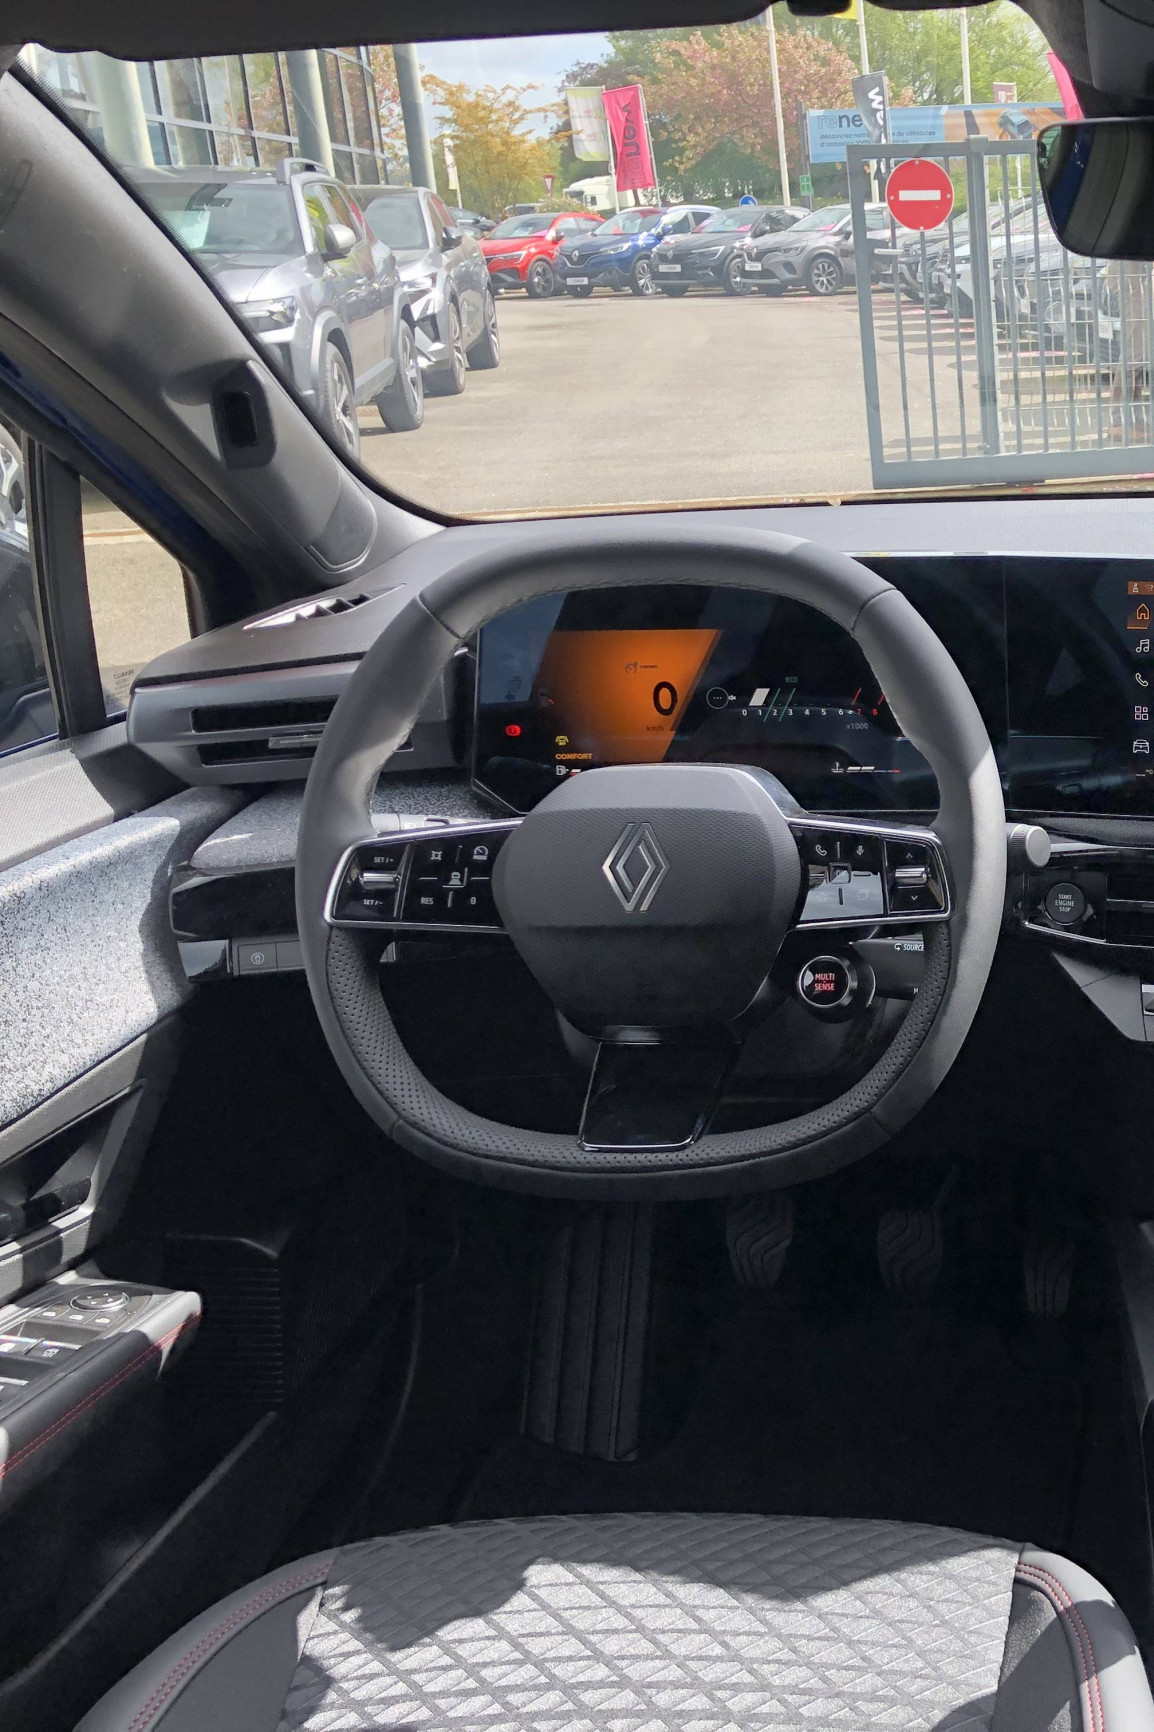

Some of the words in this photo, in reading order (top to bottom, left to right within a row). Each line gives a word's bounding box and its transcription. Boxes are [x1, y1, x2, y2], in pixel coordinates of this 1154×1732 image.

[817, 113, 863, 129] rene
[653, 681, 678, 716] 0
[742, 708, 747, 716] 0
[773, 708, 778, 716] 2
[788, 708, 793, 716] 3
[804, 708, 810, 716] 4
[821, 708, 826, 716] 5
[838, 708, 844, 716] 6
[846, 722, 869, 730] x1000
[555, 752, 593, 760] COMFORT
[420, 896, 434, 905] RES
[903, 942, 925, 952] SOURCE
[814, 972, 835, 981] MULTI
[814, 982, 835, 991] SENSE
